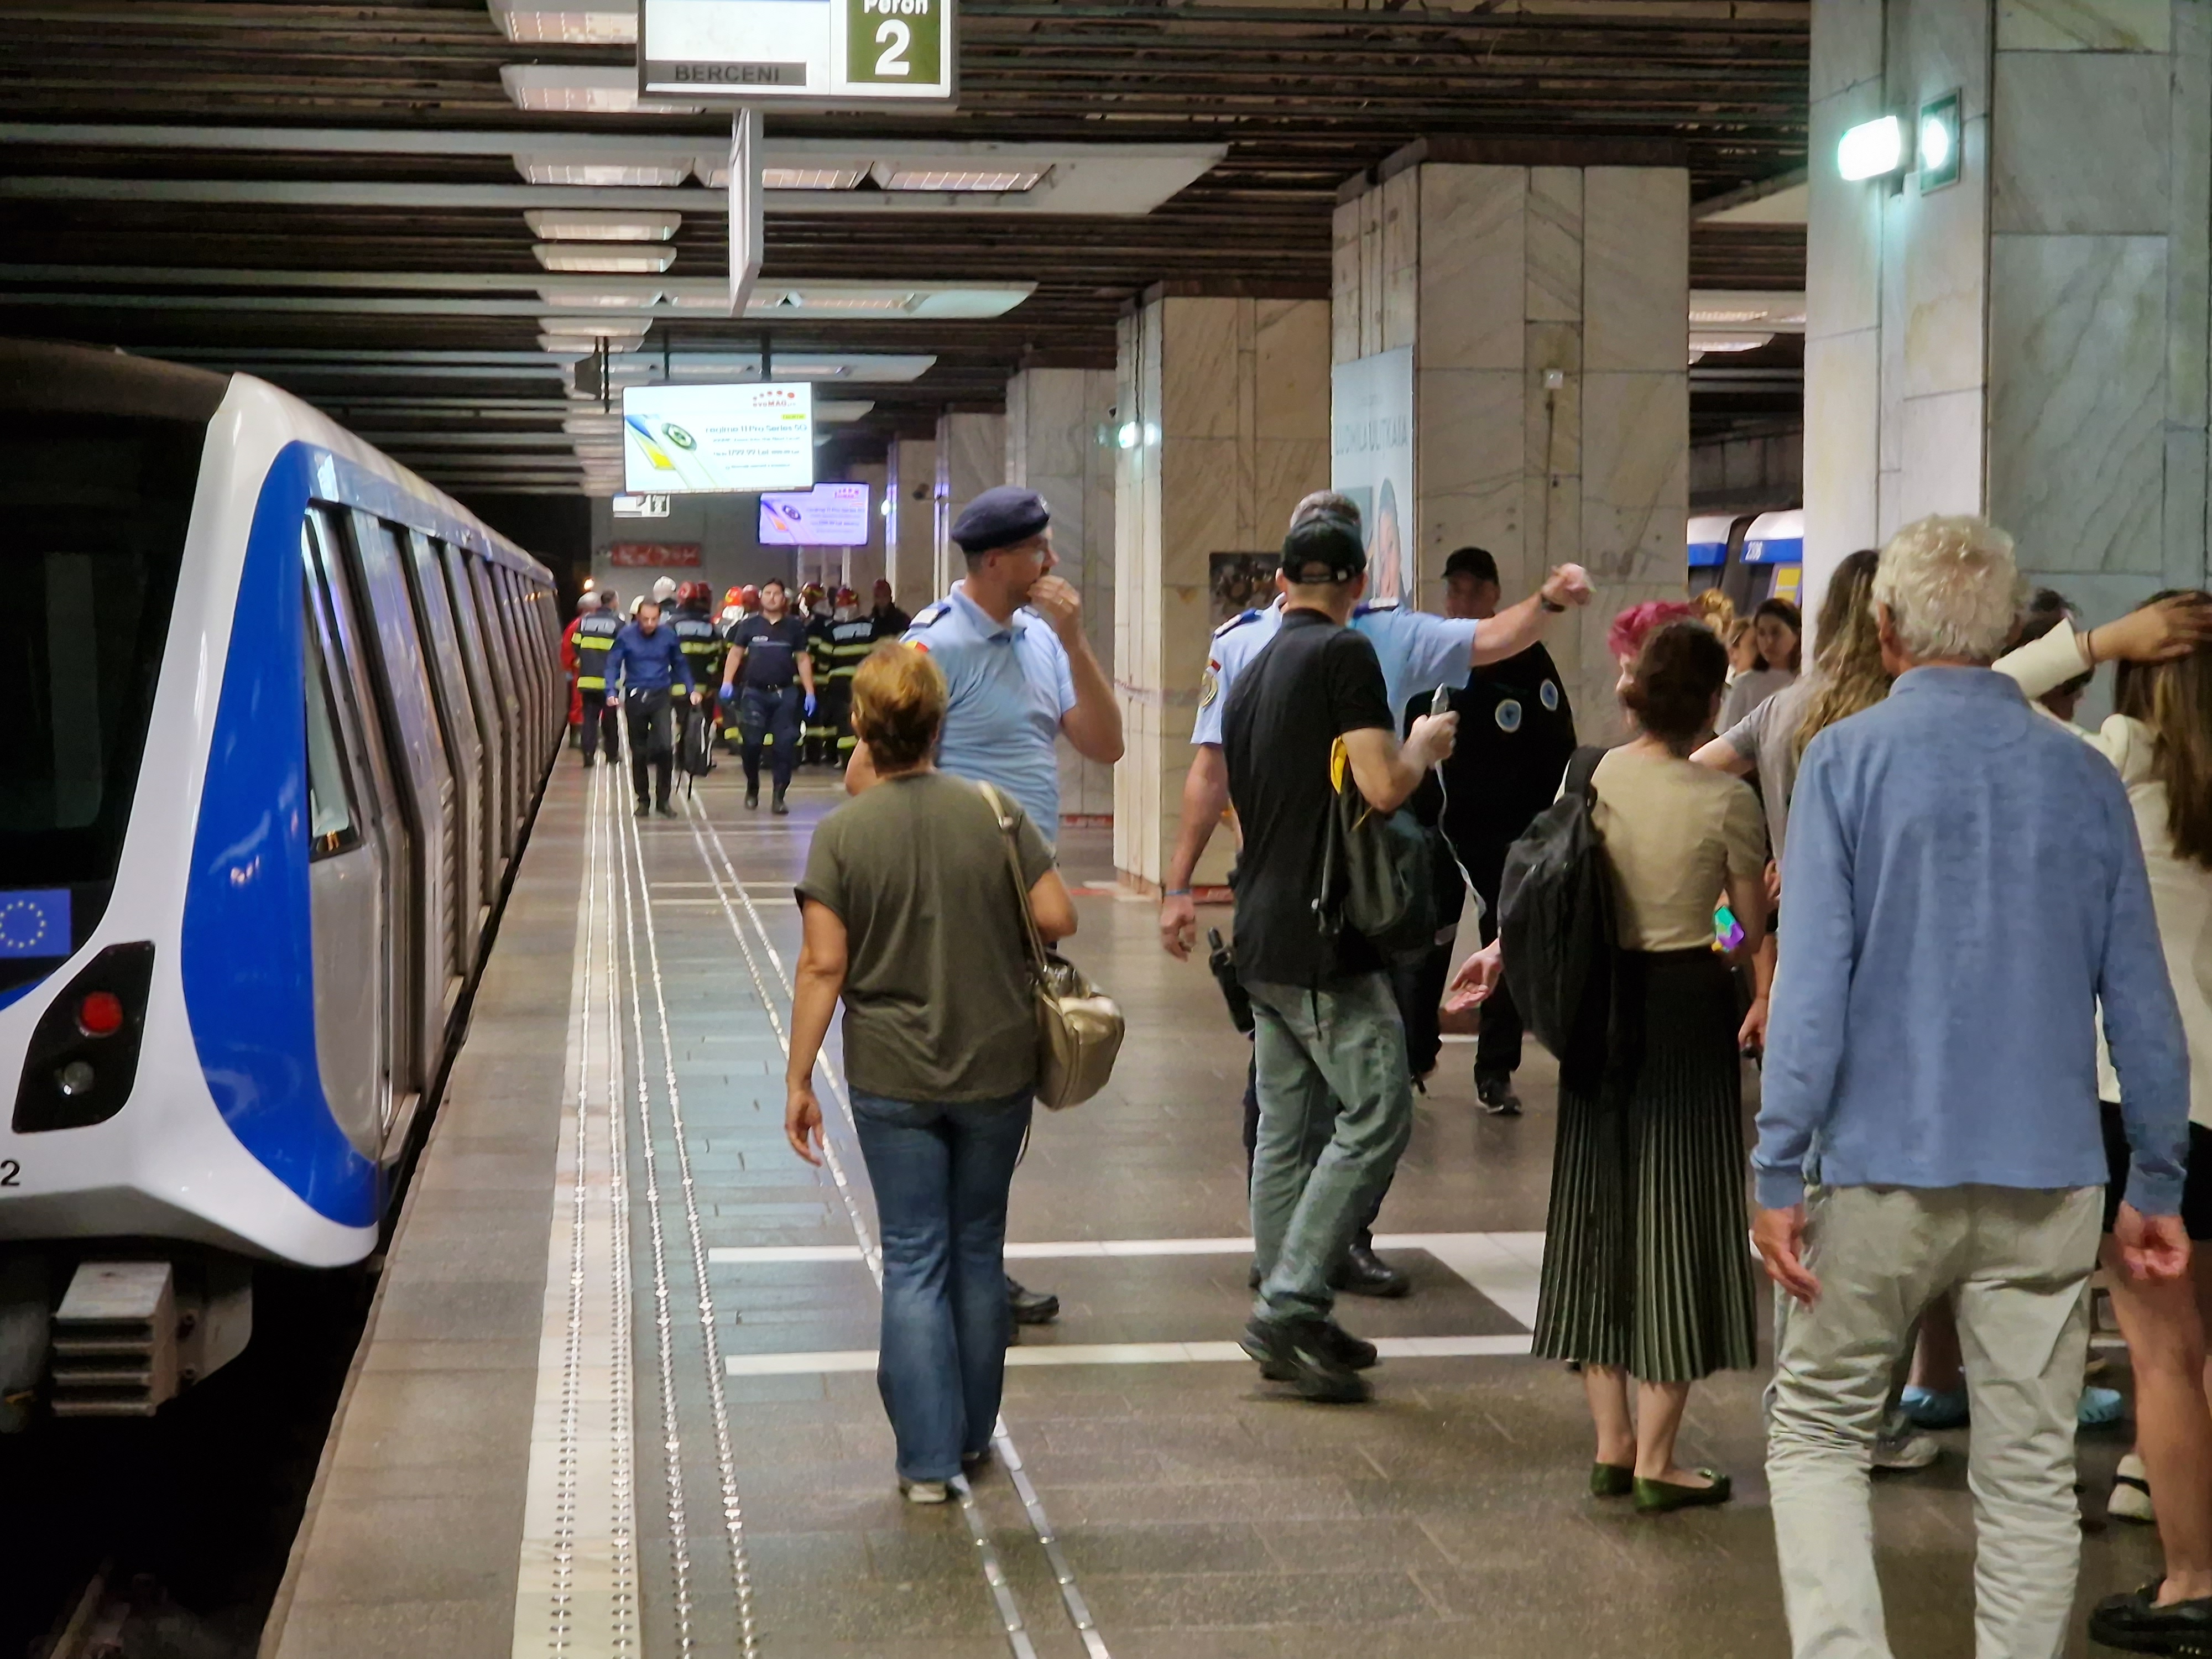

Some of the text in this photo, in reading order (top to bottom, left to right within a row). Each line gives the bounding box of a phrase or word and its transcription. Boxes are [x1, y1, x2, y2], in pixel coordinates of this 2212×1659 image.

[875, 19, 910, 76] 2
[675, 65, 779, 82] BERCENI
[0, 1160, 20, 1187] 2
